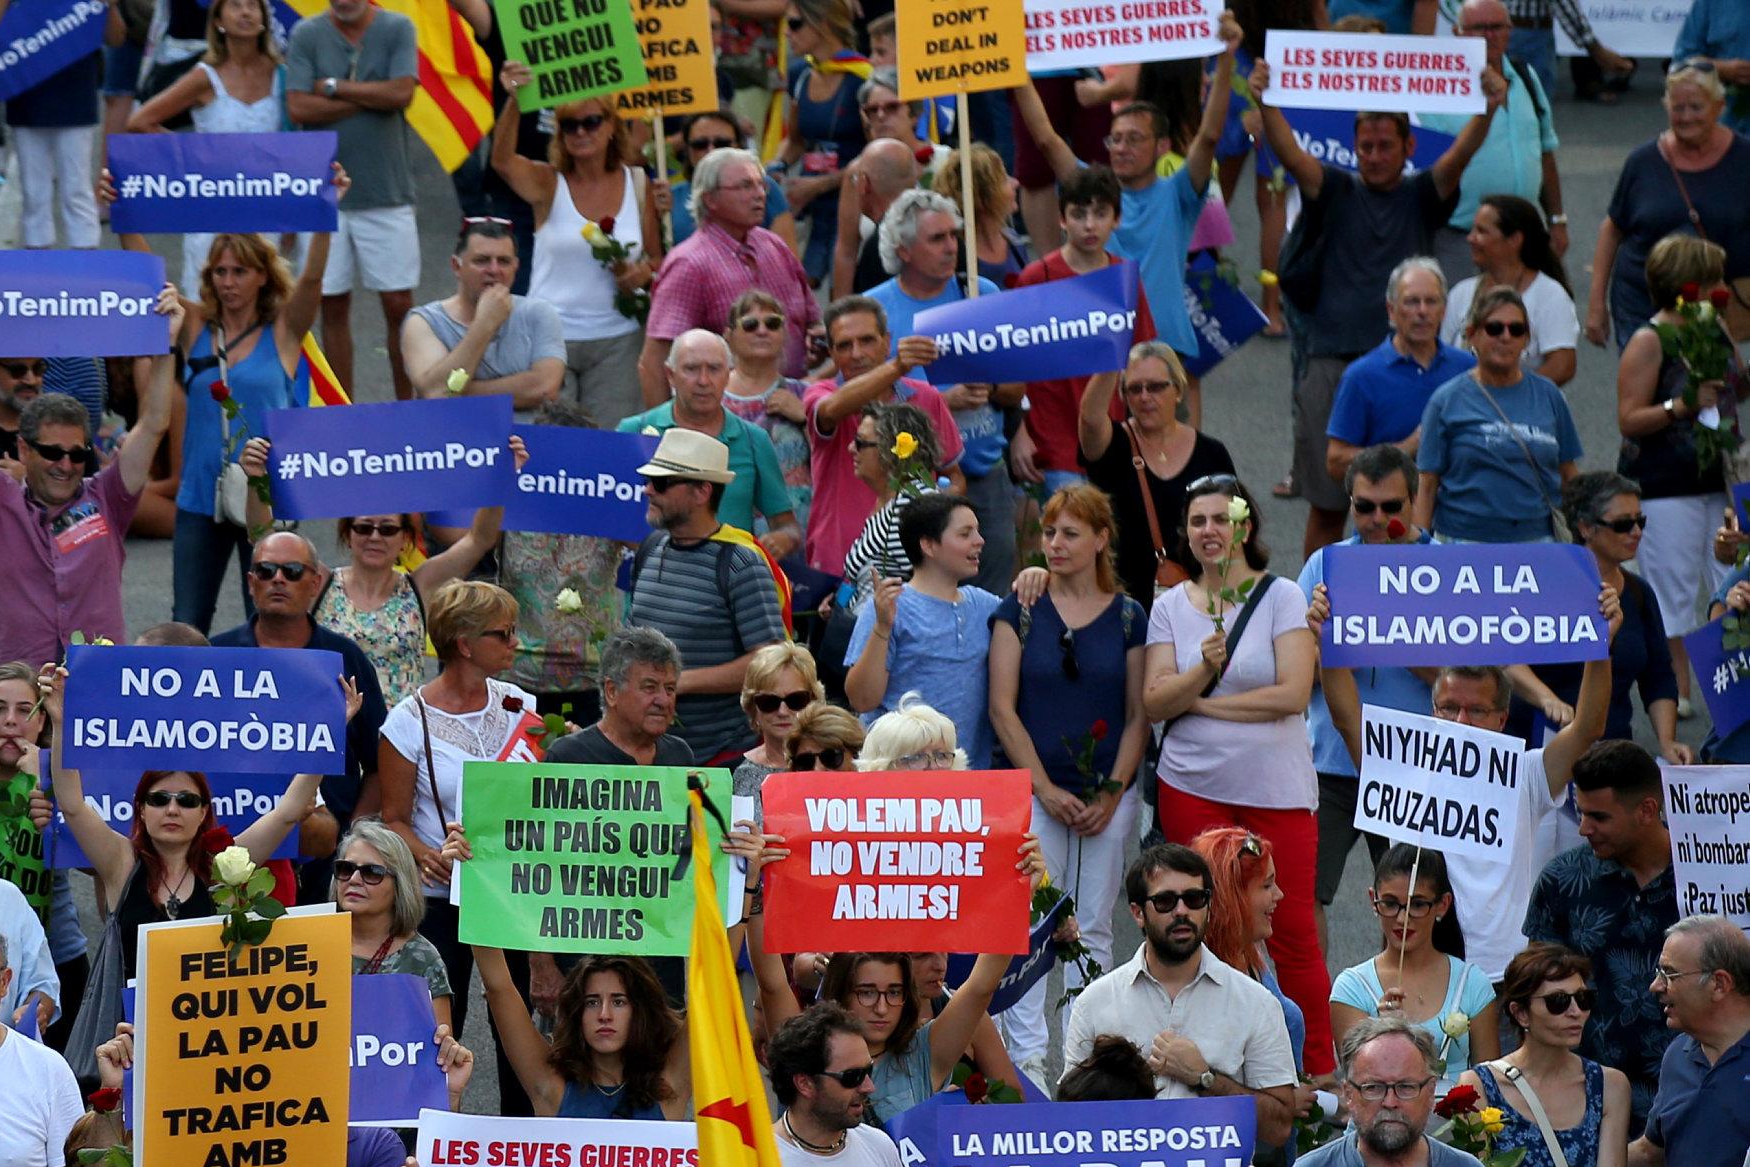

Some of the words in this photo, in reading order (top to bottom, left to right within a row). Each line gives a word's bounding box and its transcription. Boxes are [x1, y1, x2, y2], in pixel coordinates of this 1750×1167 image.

[519, 0, 569, 32] QUE
[933, 7, 988, 27] DON'T
[1025, 9, 1054, 30] LES
[1061, 6, 1116, 26] SEVES
[522, 23, 615, 65] VENGUI
[926, 36, 974, 56] DEAL
[979, 32, 997, 48] IN
[1026, 33, 1058, 53] ELS
[1061, 27, 1143, 49] NOSTRES
[1149, 21, 1210, 41] MORTS
[915, 58, 1010, 83] WEAPONS
[1284, 49, 1315, 67] LES
[1322, 50, 1377, 68] SEVES
[538, 57, 622, 99] ARMES
[1281, 72, 1312, 89] ELS
[1319, 74, 1401, 92] NOSTRES
[1408, 77, 1470, 95] MORTS
[616, 88, 694, 110] ARMES
[121, 173, 323, 197] #NoTenimPor
[934, 310, 1137, 356] #NoTenimPor
[279, 443, 499, 479] #NoTenimPor
[1380, 566, 1440, 594] NO
[1453, 566, 1480, 593] A
[1494, 566, 1539, 593] LA
[1334, 607, 1598, 644] ISLAMOFÒBIA
[122, 668, 181, 696] NO
[193, 670, 221, 697] A
[234, 670, 279, 698] LA
[74, 713, 335, 751] ISLAMOFÒBIA
[1488, 747, 1518, 788] NI
[532, 777, 662, 811] IMAGINA
[1668, 783, 1690, 814] Ni
[1694, 787, 1750, 824] atrope
[805, 799, 916, 832] VOLEM
[921, 799, 989, 835] PAU,
[1363, 780, 1503, 848] CRUZADAS.
[505, 820, 545, 851] UN
[554, 816, 621, 854] PAÍS
[1677, 833, 1691, 863] ni
[811, 841, 852, 875] NO
[857, 842, 984, 876] VENDRE
[512, 863, 551, 895] NO
[560, 864, 669, 898] VENGUI
[833, 885, 958, 919] ARMES!
[540, 907, 643, 941] ARMES
[180, 942, 319, 981] FELIPE,
[172, 989, 238, 1020] QUI
[248, 983, 326, 1014] VOL
[179, 1030, 229, 1059] LA
[239, 1021, 317, 1054] PAU
[215, 1064, 271, 1094] NO
[163, 1097, 330, 1136] TRAFICA
[432, 1139, 479, 1165] LES
